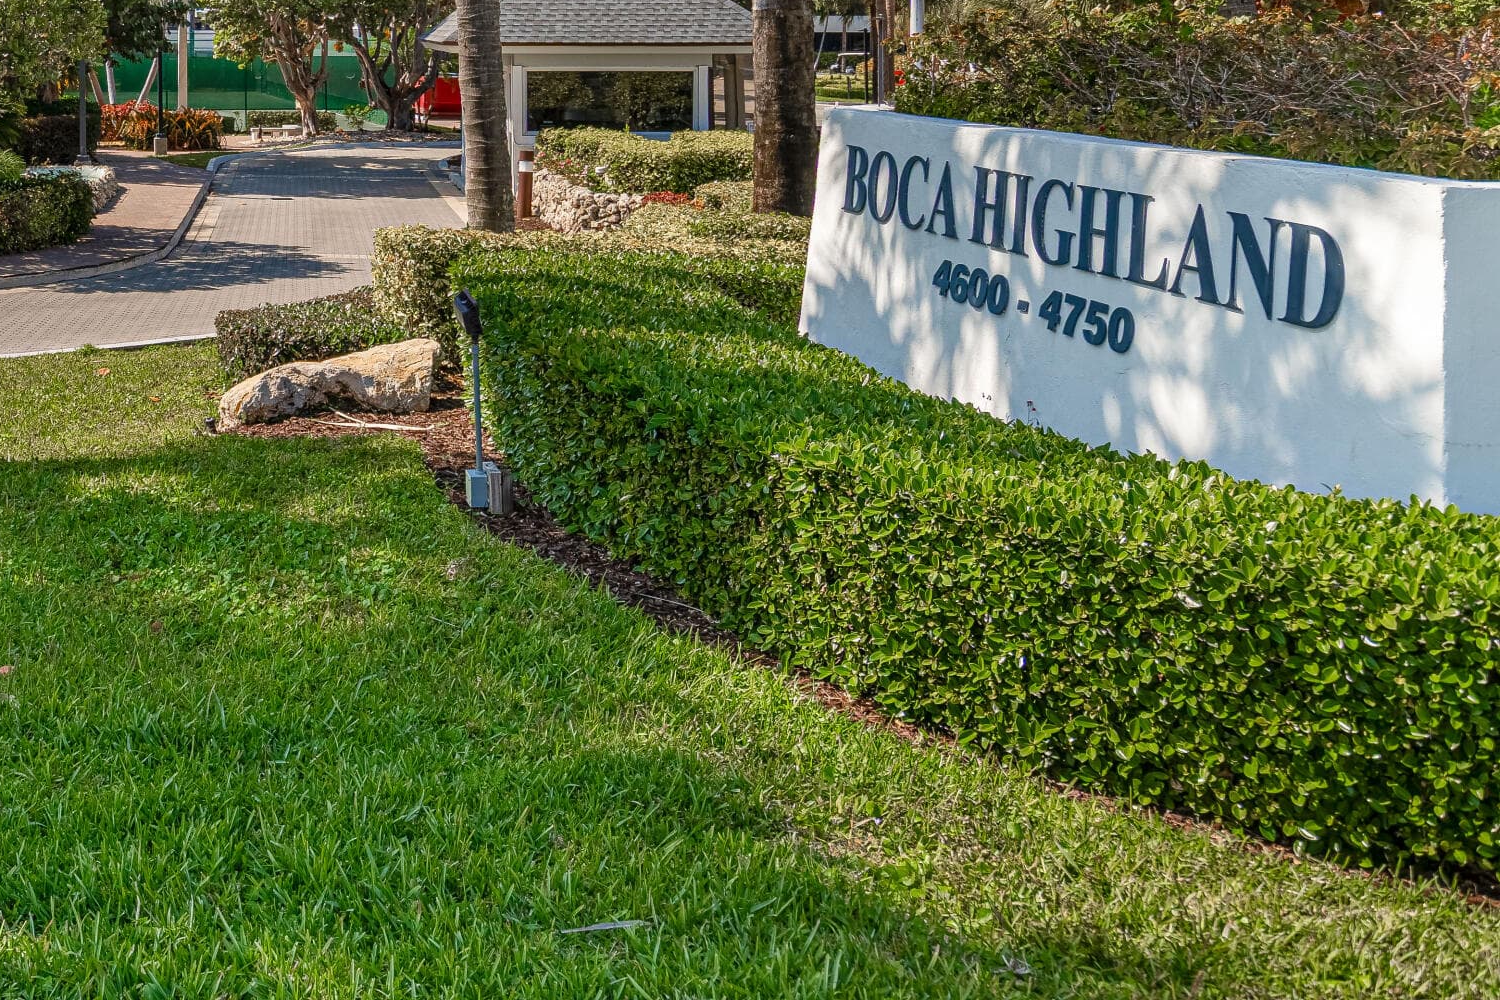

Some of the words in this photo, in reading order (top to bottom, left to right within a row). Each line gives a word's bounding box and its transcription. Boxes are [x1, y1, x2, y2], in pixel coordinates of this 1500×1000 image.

[842, 144, 959, 240] BOCA
[968, 165, 1346, 329] HIGHLAND
[932, 259, 1010, 316] 4600
[1038, 290, 1135, 354] 4750
